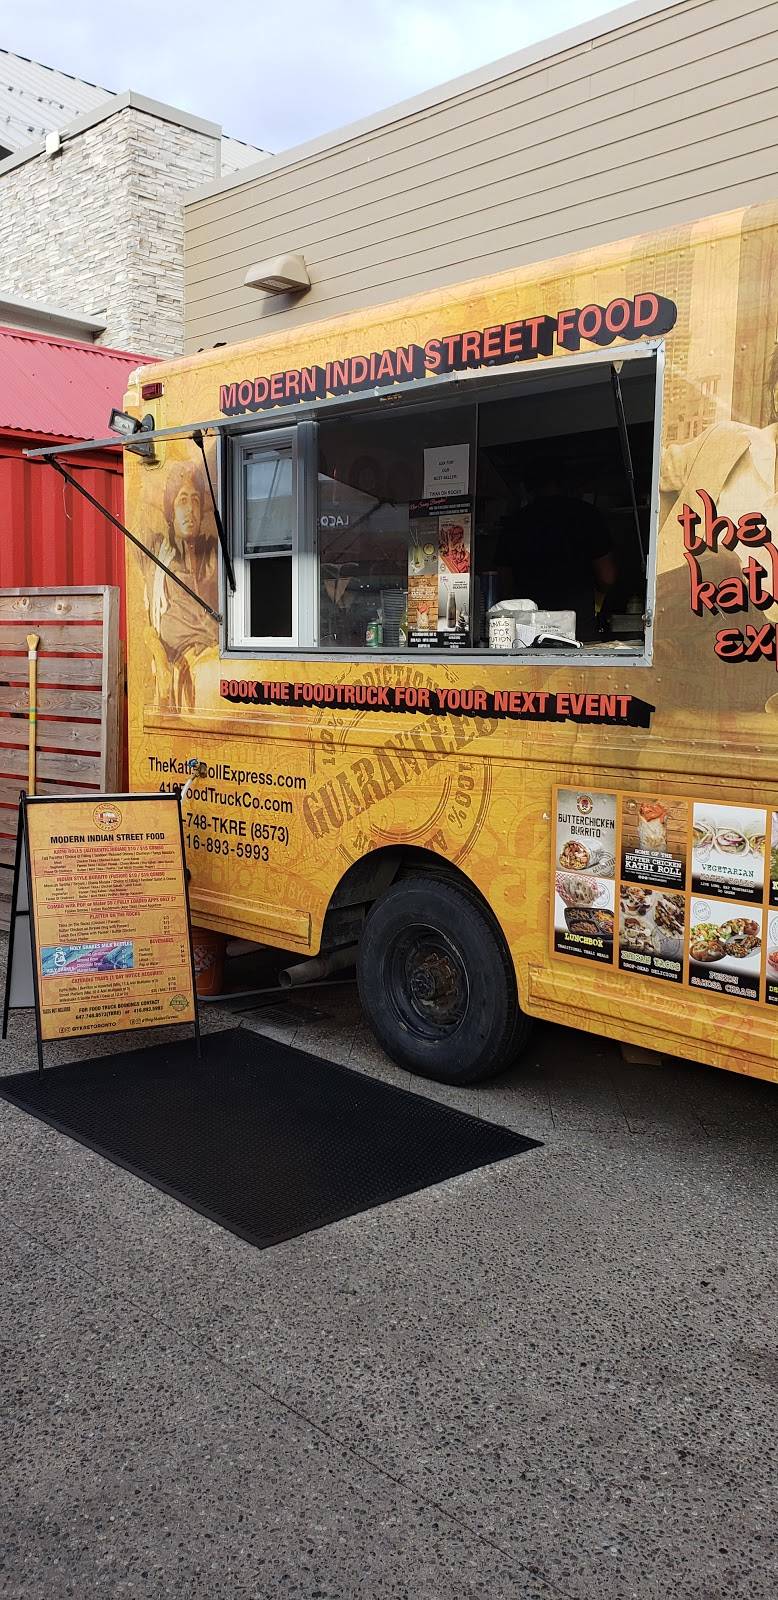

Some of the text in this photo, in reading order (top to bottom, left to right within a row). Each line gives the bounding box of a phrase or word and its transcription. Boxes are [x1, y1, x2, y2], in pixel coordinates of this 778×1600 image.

[219, 292, 667, 411] MODERN INDIAN STREET FOOD
[677, 488, 770, 555] the
[220, 679, 638, 721] BOOK THE FOODTRUCK FOR YOUR NEXT EVENT
[558, 814, 614, 830] BUTTERCHICKEN
[250, 822, 289, 846] (8573)
[570, 826, 600, 838] BURRITO
[50, 836, 85, 844] MODERN
[625, 855, 682, 868] BUTTER CHICKEN
[625, 861, 654, 871] KATHI
[658, 866, 681, 875] ROLL
[702, 864, 754, 878] VEGETARIAN
[564, 932, 603, 947] LUNCHBOX
